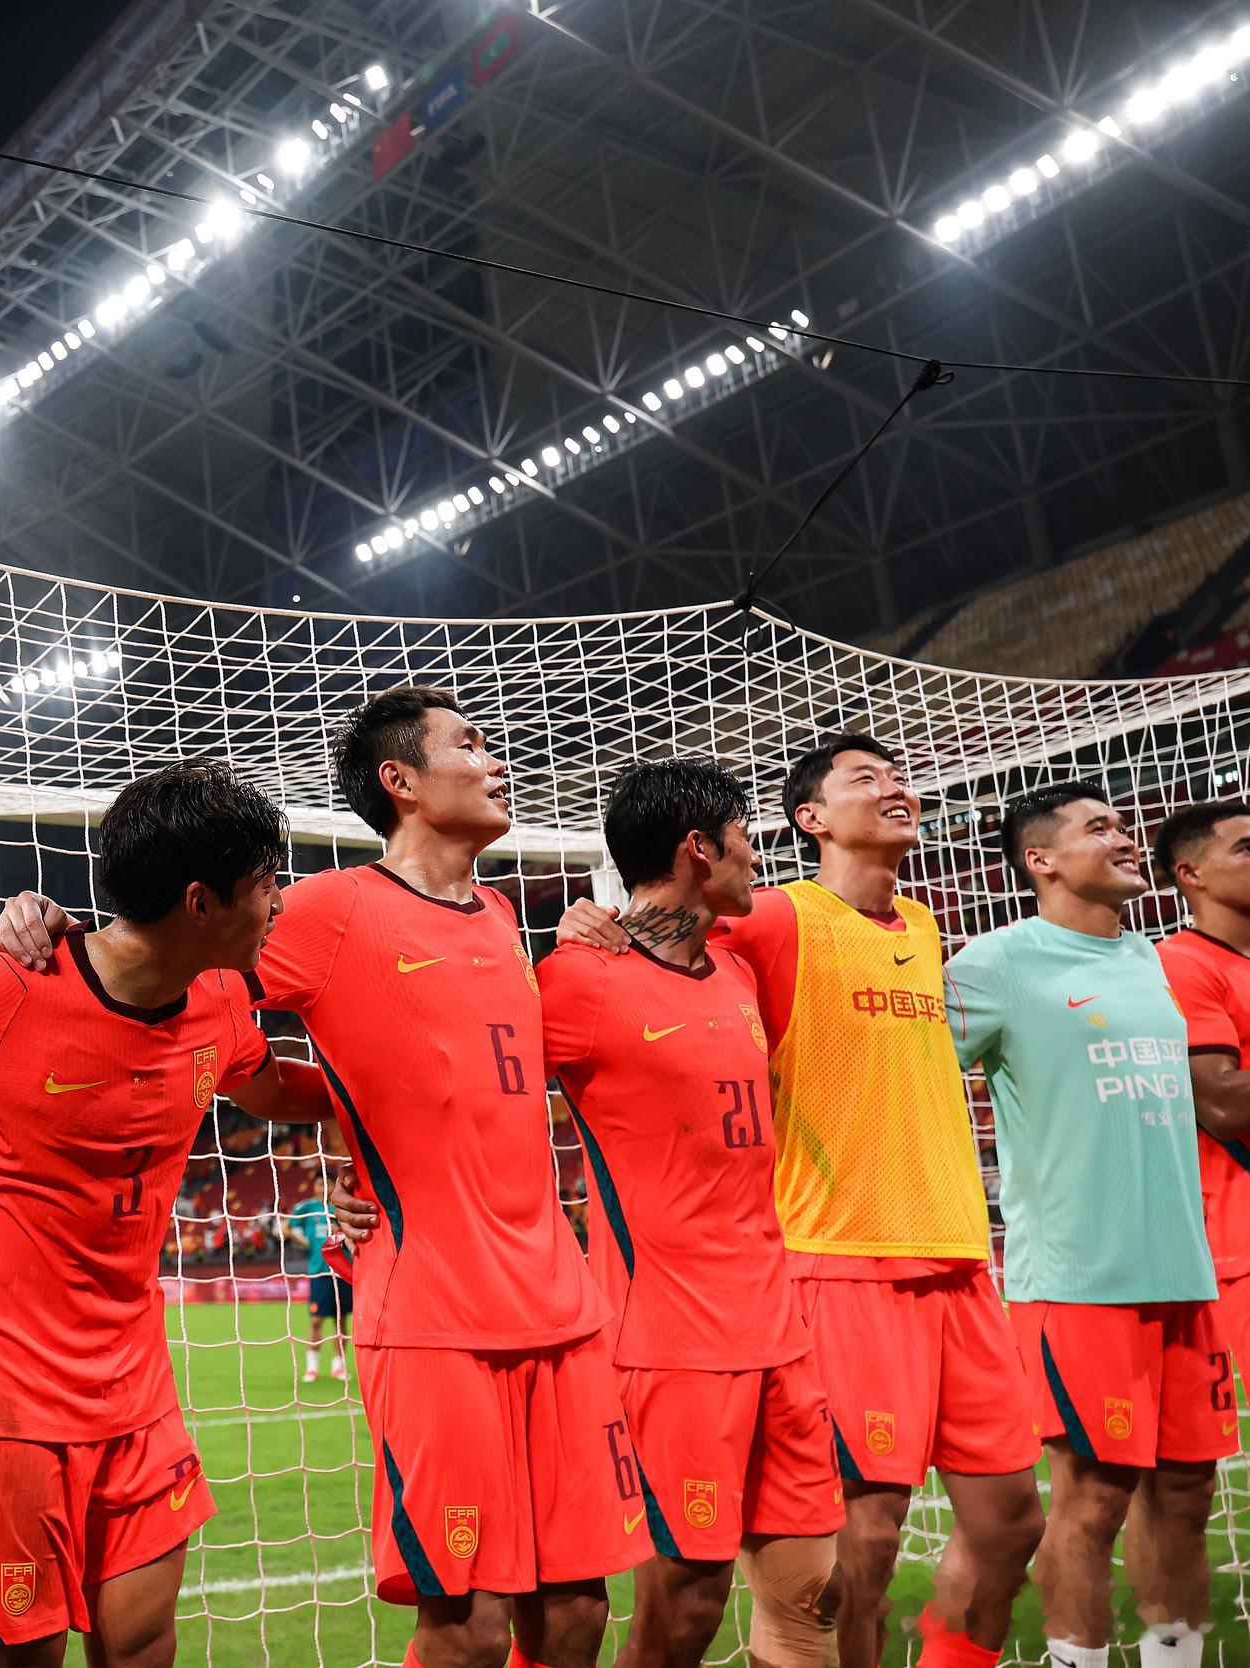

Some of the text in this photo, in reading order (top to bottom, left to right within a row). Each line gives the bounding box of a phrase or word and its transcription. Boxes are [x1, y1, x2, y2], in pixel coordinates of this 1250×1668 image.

[196, 1050, 215, 1064] CFA
[485, 1023, 529, 1095] 6
[713, 1080, 766, 1148] 21
[114, 1145, 154, 1218] 3
[602, 1420, 639, 1501] 6
[448, 1509, 475, 1519] CFA
[4, 1566, 33, 1577] CFA
